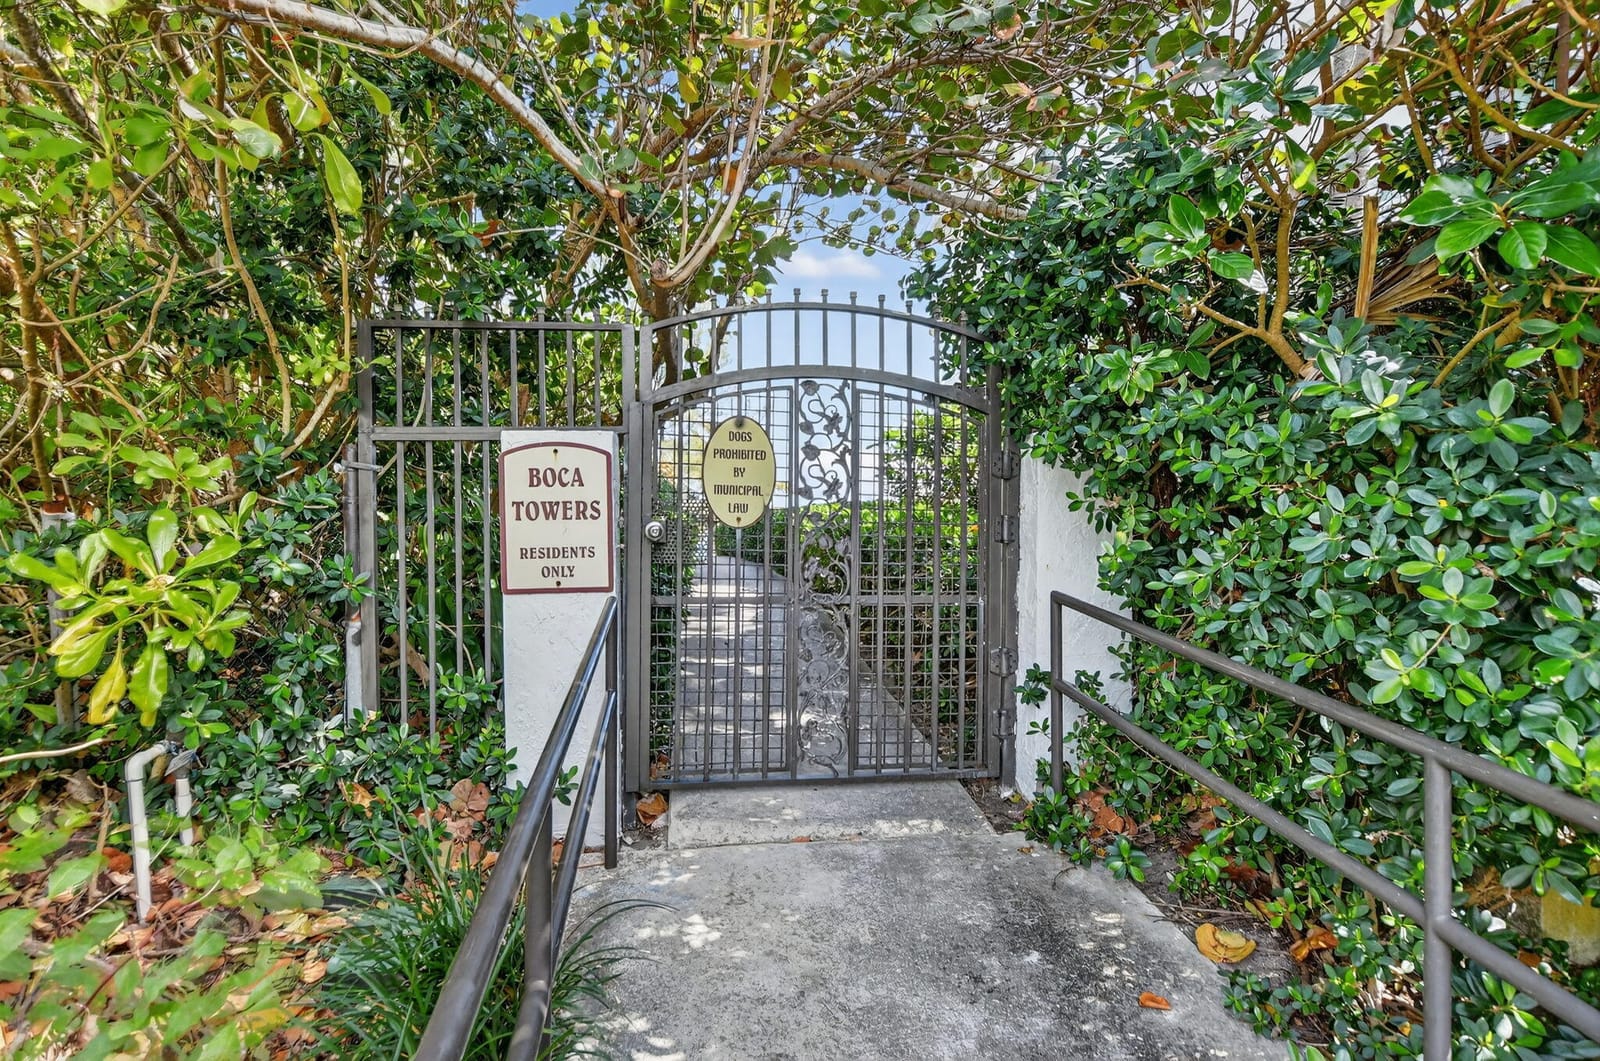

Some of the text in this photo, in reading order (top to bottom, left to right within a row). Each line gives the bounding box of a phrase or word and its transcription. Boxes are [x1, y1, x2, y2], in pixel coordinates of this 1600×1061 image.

[728, 431, 752, 442] DOGS
[713, 448, 766, 461] PROHIBITED
[528, 467, 585, 488] BOCA
[733, 467, 746, 478] BY
[714, 484, 764, 497] MUNICIPAL
[511, 500, 601, 521] TOWERS
[728, 503, 749, 514] LAW
[519, 546, 595, 559] RESIDENTS
[541, 566, 575, 578] ONLY
